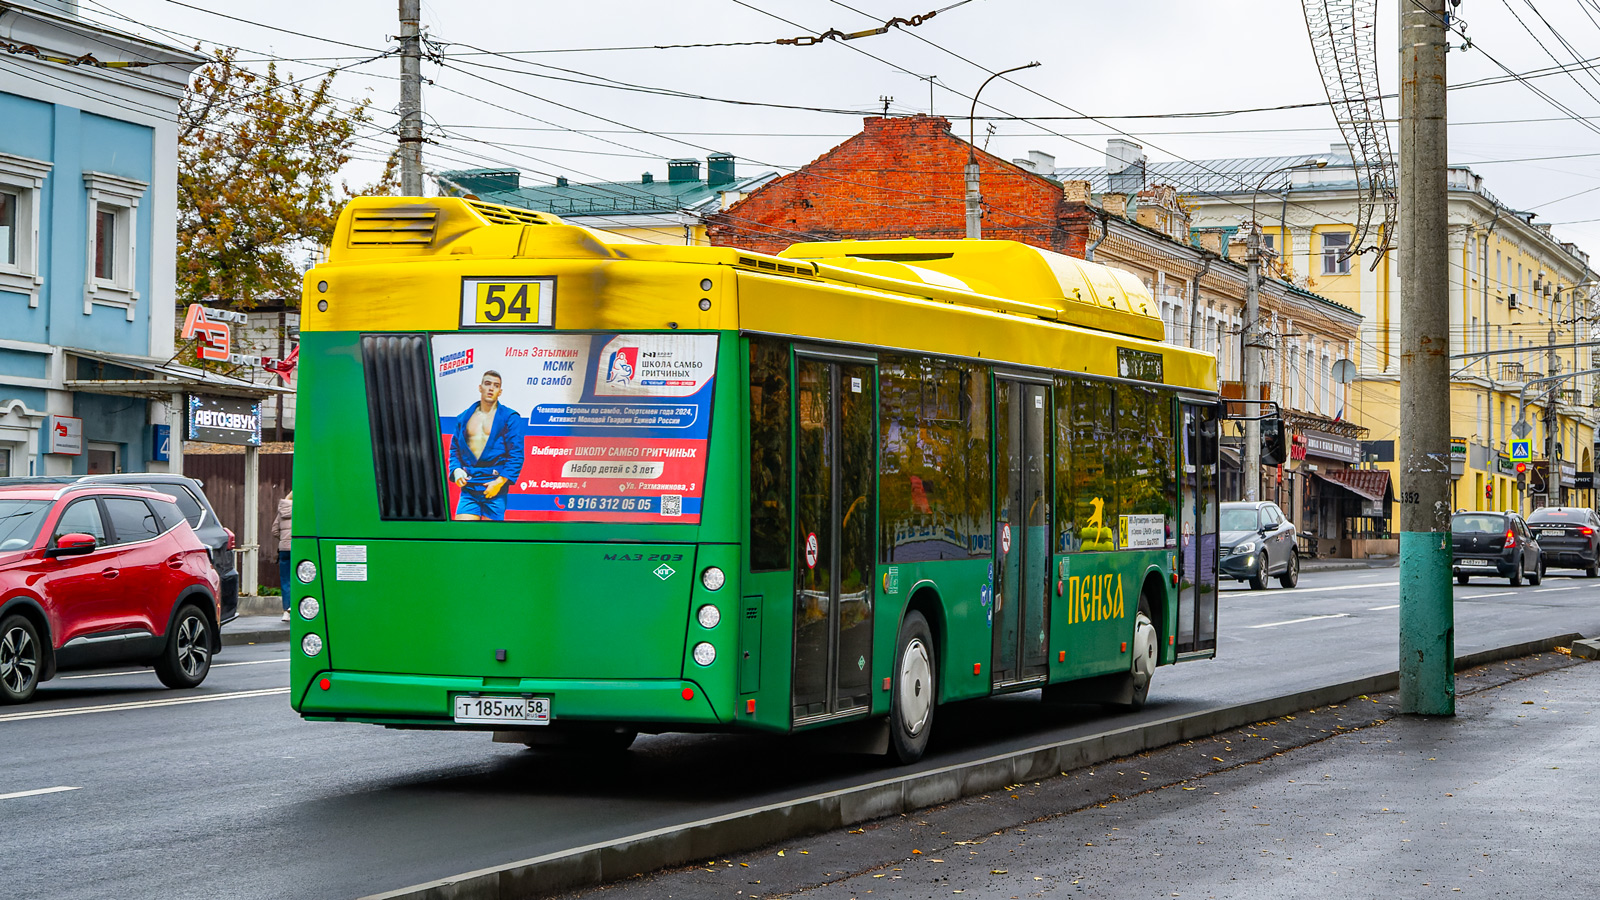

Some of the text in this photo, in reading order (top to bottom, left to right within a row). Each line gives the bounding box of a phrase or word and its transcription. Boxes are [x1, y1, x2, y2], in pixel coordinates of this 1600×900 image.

[484, 284, 531, 322] 54
[505, 347, 579, 358] Илья Затылкин
[543, 360, 575, 372] МСМК
[641, 360, 703, 369] ШКОЛА САМБО
[641, 369, 690, 378] ГРИТЧИНЫХ
[527, 375, 572, 386] по самбо
[536, 406, 564, 414] Чемпион
[565, 406, 589, 415] Европы
[623, 406, 658, 415] Спортсмен
[659, 408, 674, 416] года
[674, 407, 693, 416] 2024,
[195, 409, 257, 430] АВТОЗВУК
[548, 415, 680, 425] Активист Молодой Гвардии Единой России
[531, 445, 697, 458] Выбирает ШКОЛУ САМБО ГРИТЧИНЫХ
[570, 463, 655, 475] Набор детей с 3 лет
[528, 480, 539, 488] Ул.
[581, 481, 587, 489] 4
[626, 482, 637, 490] Ул.
[689, 483, 696, 491] 3
[567, 497, 652, 511] 8 916 312 05 05
[1068, 573, 1124, 624] ПЕНЗА
[527, 701, 543, 713] 58
